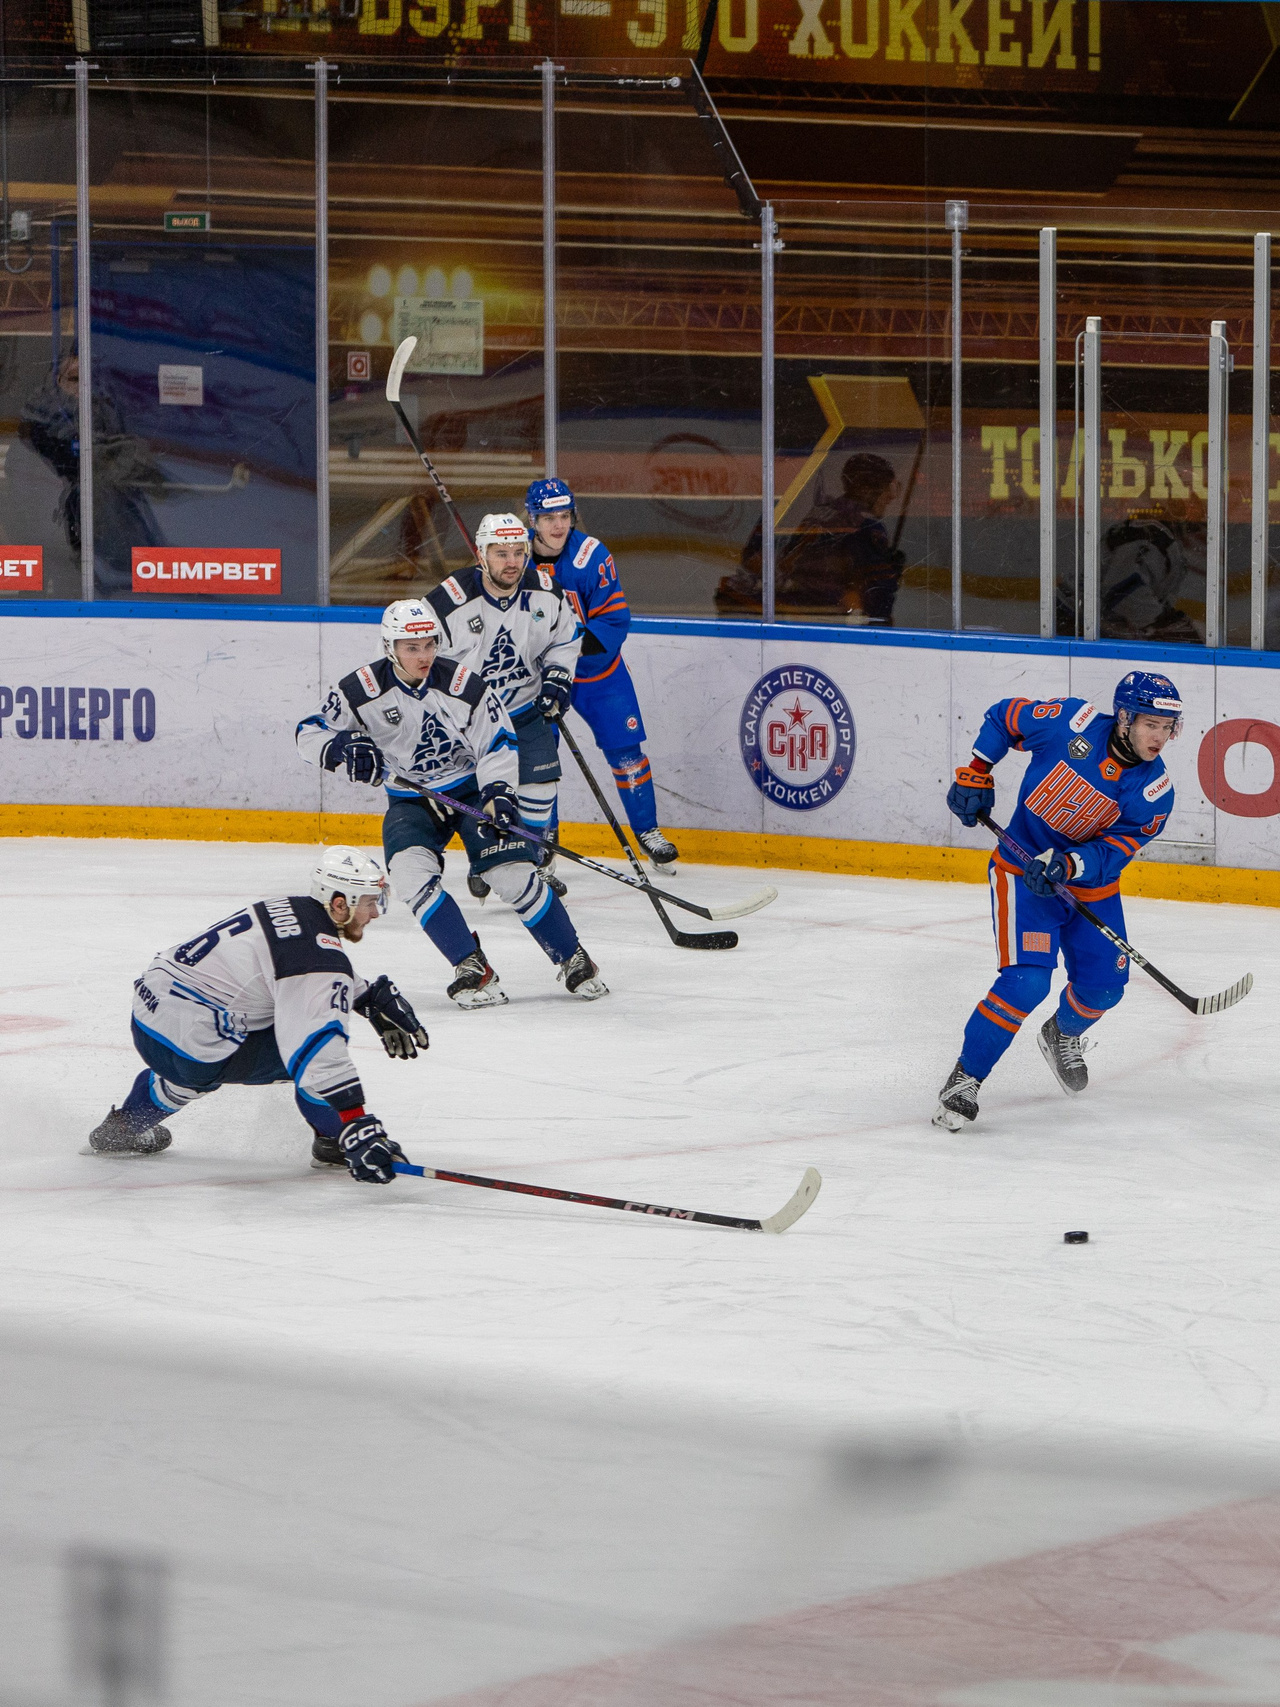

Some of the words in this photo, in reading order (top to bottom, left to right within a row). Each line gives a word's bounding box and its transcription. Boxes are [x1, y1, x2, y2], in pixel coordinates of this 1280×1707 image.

[0, 559, 38, 577] ET
[136, 561, 277, 581] OLIMPBET
[410, 607, 423, 616] 54
[745, 671, 851, 756] САНКТ-ПЕТЕРБУРГ
[767, 720, 829, 772] СКА
[958, 771, 995, 786] CCM
[763, 776, 833, 805] ХОККЕЙ
[173, 907, 254, 968] 6
[623, 1201, 696, 1221] CCM
